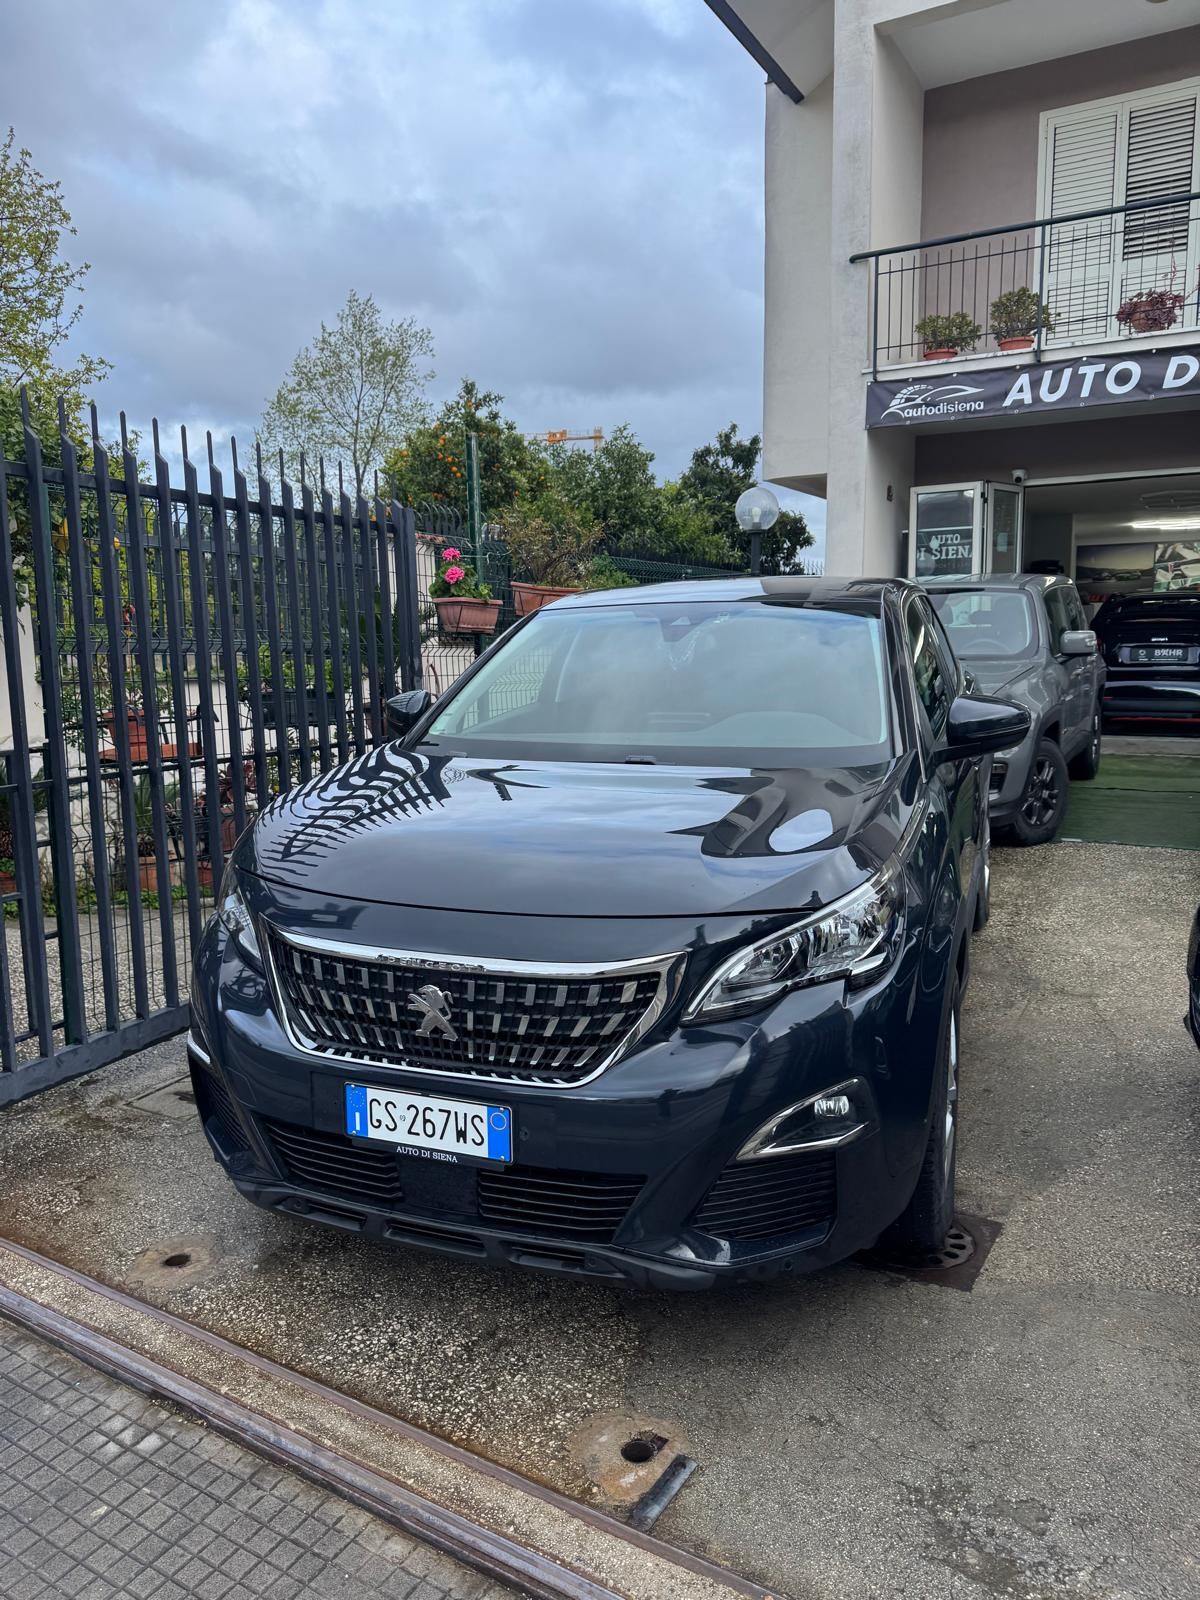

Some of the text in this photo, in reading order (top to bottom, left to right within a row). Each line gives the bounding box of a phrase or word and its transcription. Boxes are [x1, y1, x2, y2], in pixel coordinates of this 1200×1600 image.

[1002, 355, 1199, 407] AUTO D
[904, 400, 984, 418] autodisiena
[931, 545, 972, 560] SIEN
[396, 1145, 458, 1163] AUTO DI SIENA
